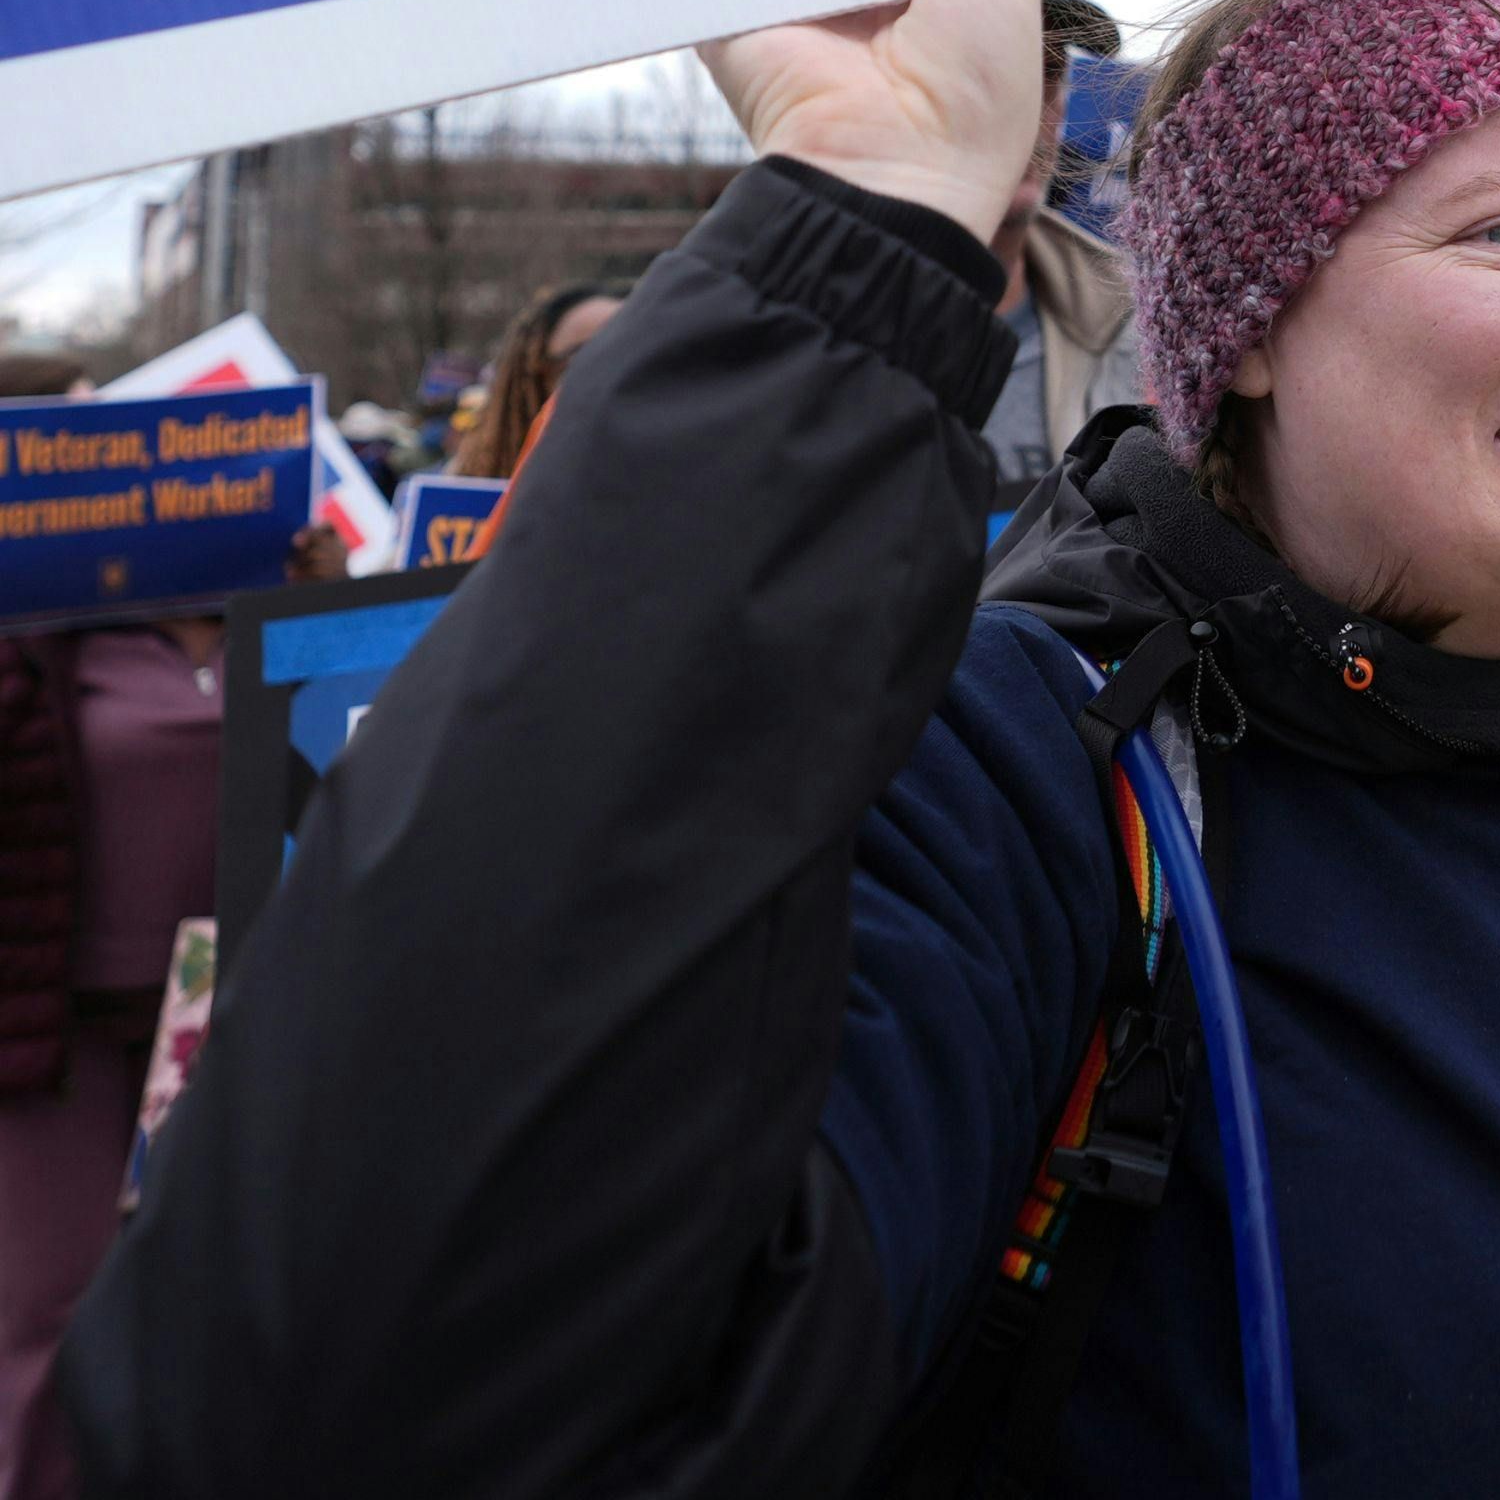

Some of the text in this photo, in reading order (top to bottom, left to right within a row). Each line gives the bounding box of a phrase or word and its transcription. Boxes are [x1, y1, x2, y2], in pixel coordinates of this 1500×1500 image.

[15, 427, 151, 474] Veteran,
[157, 404, 312, 465] Dedicated
[152, 466, 275, 524] Worker!
